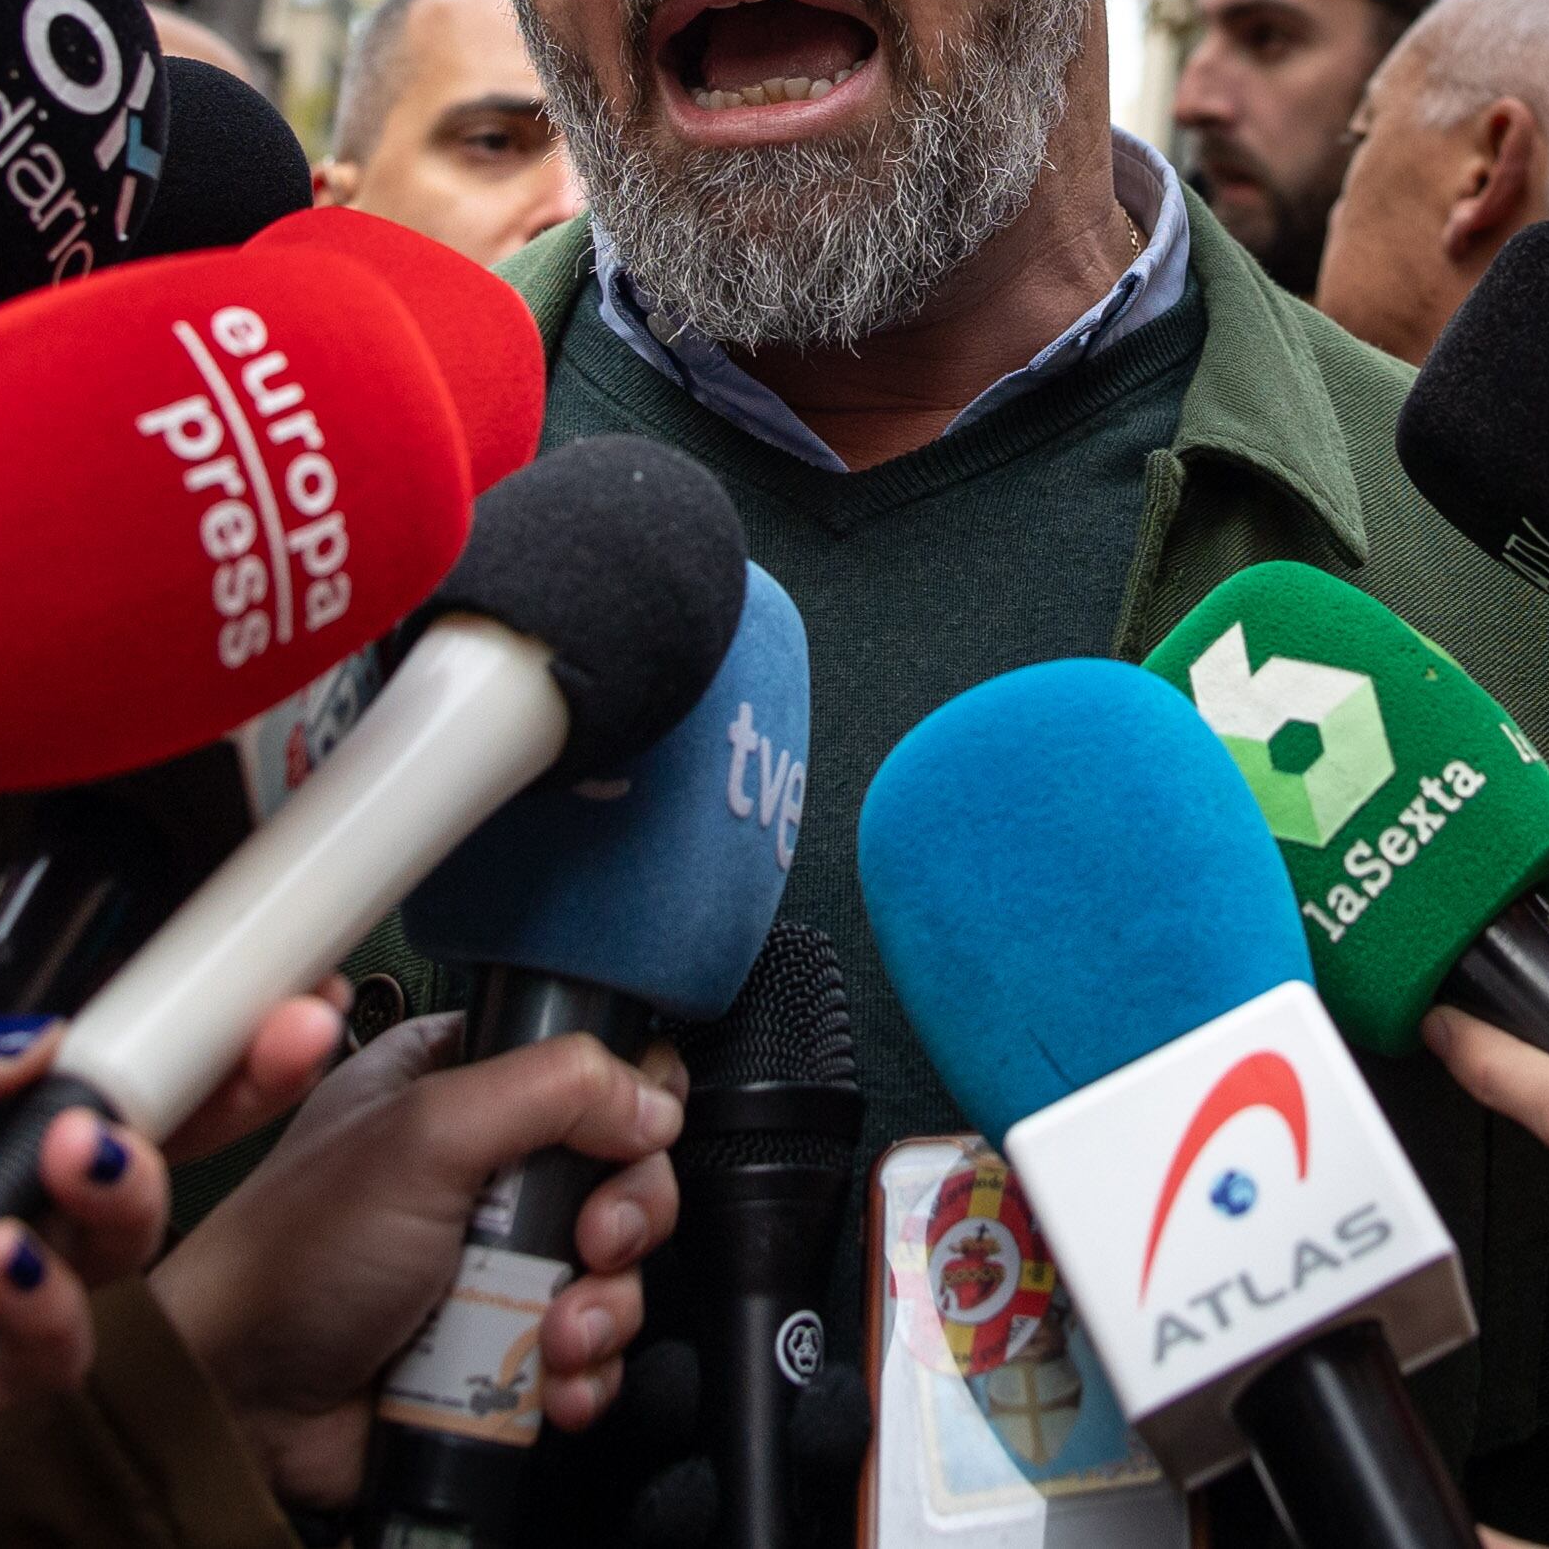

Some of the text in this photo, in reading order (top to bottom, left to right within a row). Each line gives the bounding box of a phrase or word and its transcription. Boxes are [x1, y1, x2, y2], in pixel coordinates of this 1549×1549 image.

[135, 393, 271, 669] press
[210, 305, 353, 633] europa
[1302, 759, 1487, 943] laSexta
[1154, 1200, 1393, 1364] ATLAS
